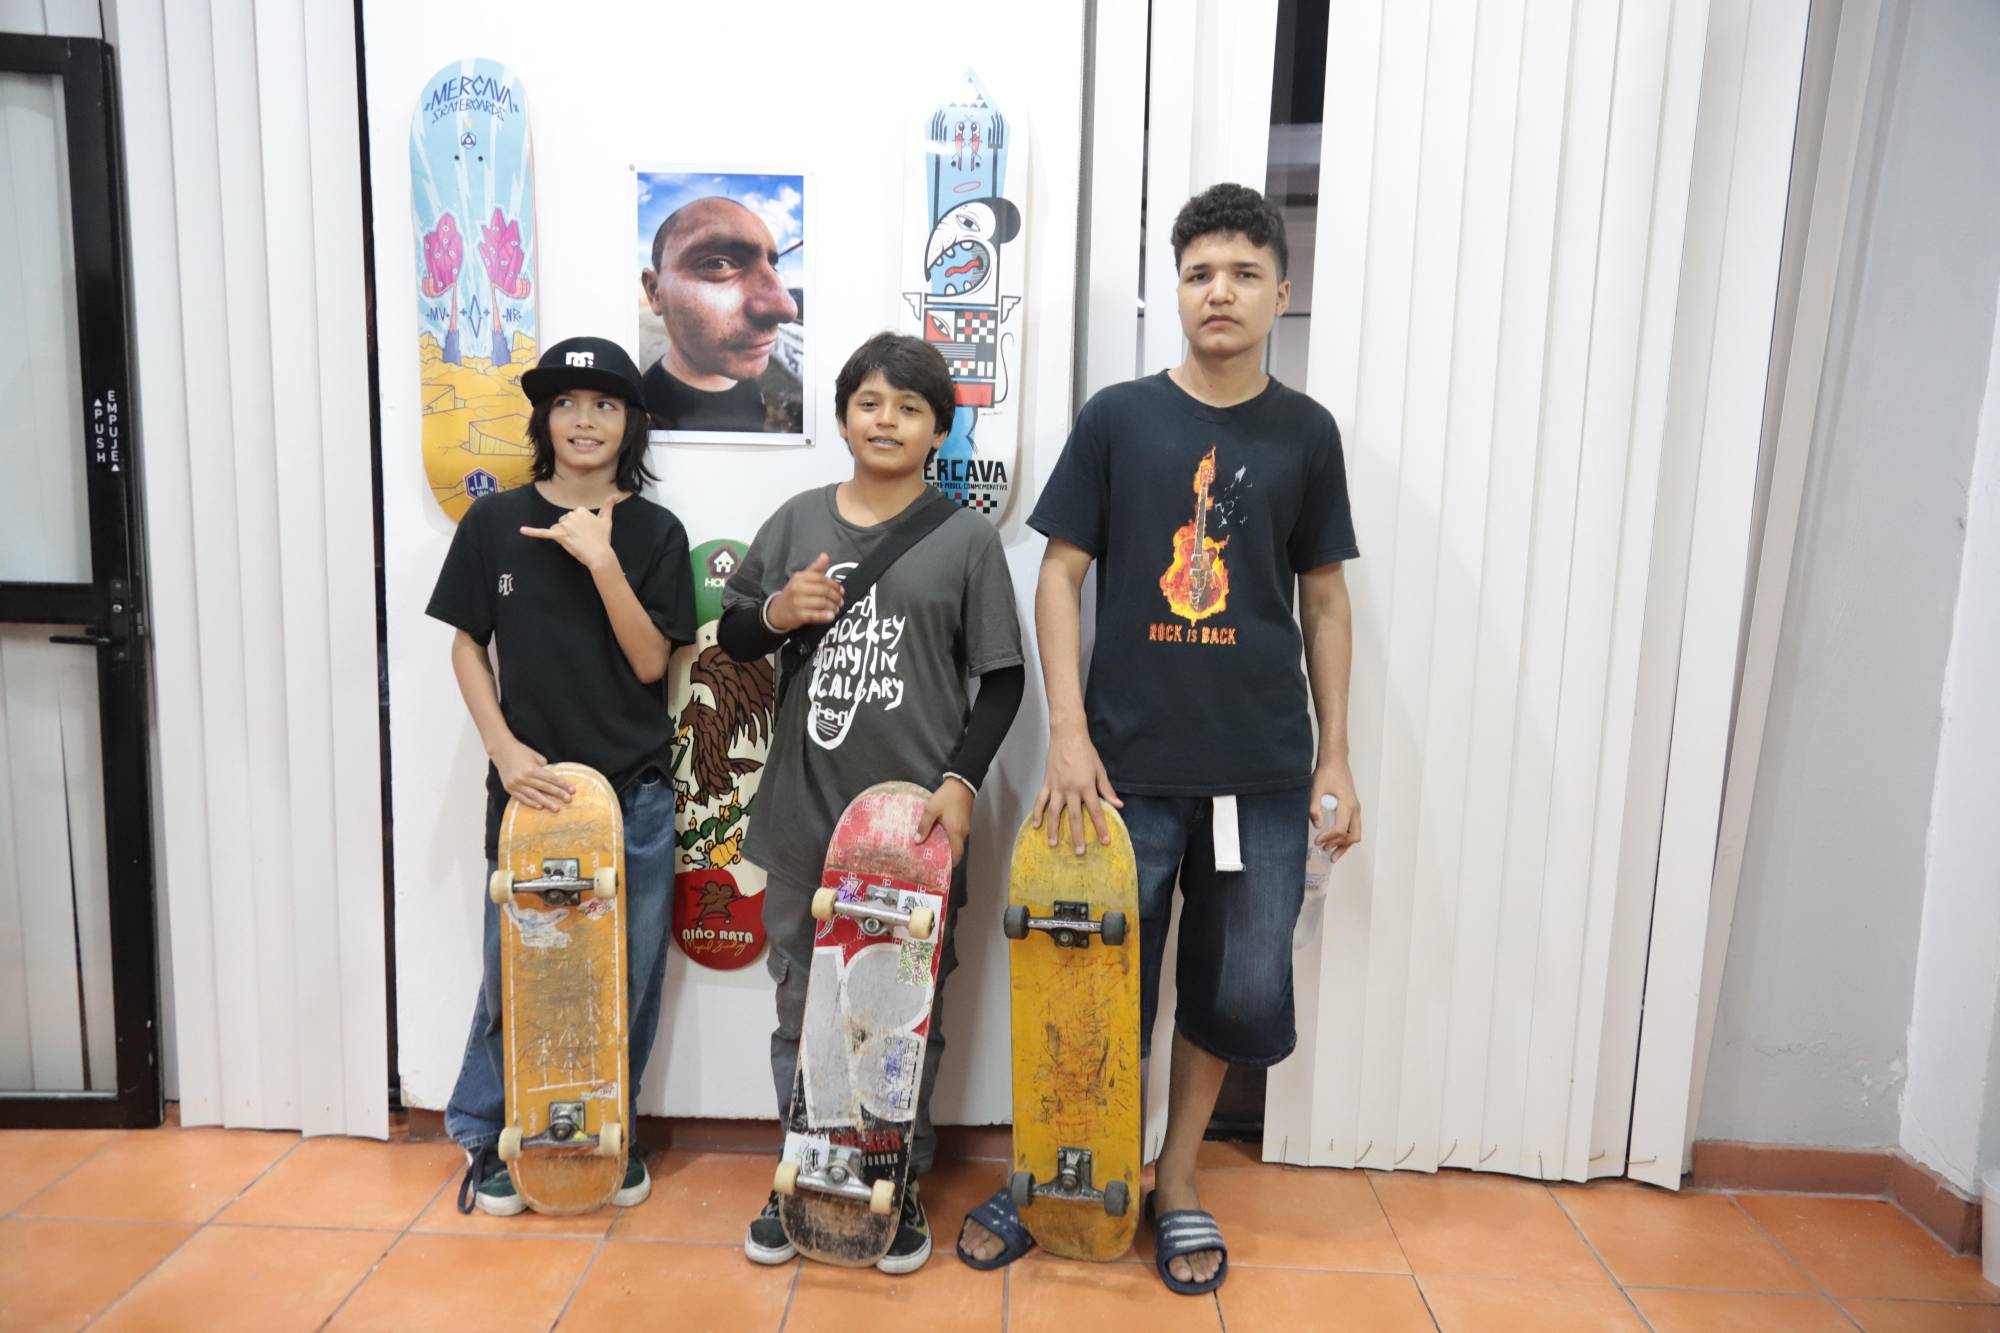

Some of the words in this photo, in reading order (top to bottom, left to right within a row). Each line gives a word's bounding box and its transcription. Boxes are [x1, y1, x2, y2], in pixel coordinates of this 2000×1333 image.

[431, 75, 512, 112] MERCAVA
[432, 97, 505, 122] SKATEBOARDS
[94, 408, 106, 463] PUSH
[107, 390, 119, 462] EMPUJE
[924, 459, 1007, 483] ERCAVA
[825, 615, 906, 650] HOCKEY
[1149, 623, 1182, 642] ROCK
[1186, 628, 1198, 643] IS
[1201, 626, 1236, 645] BACK
[822, 645, 861, 676] DAY
[869, 646, 899, 676] IN
[816, 673, 905, 711] CALGARY
[682, 927, 715, 940] NIÑO
[719, 930, 754, 944] RATA
